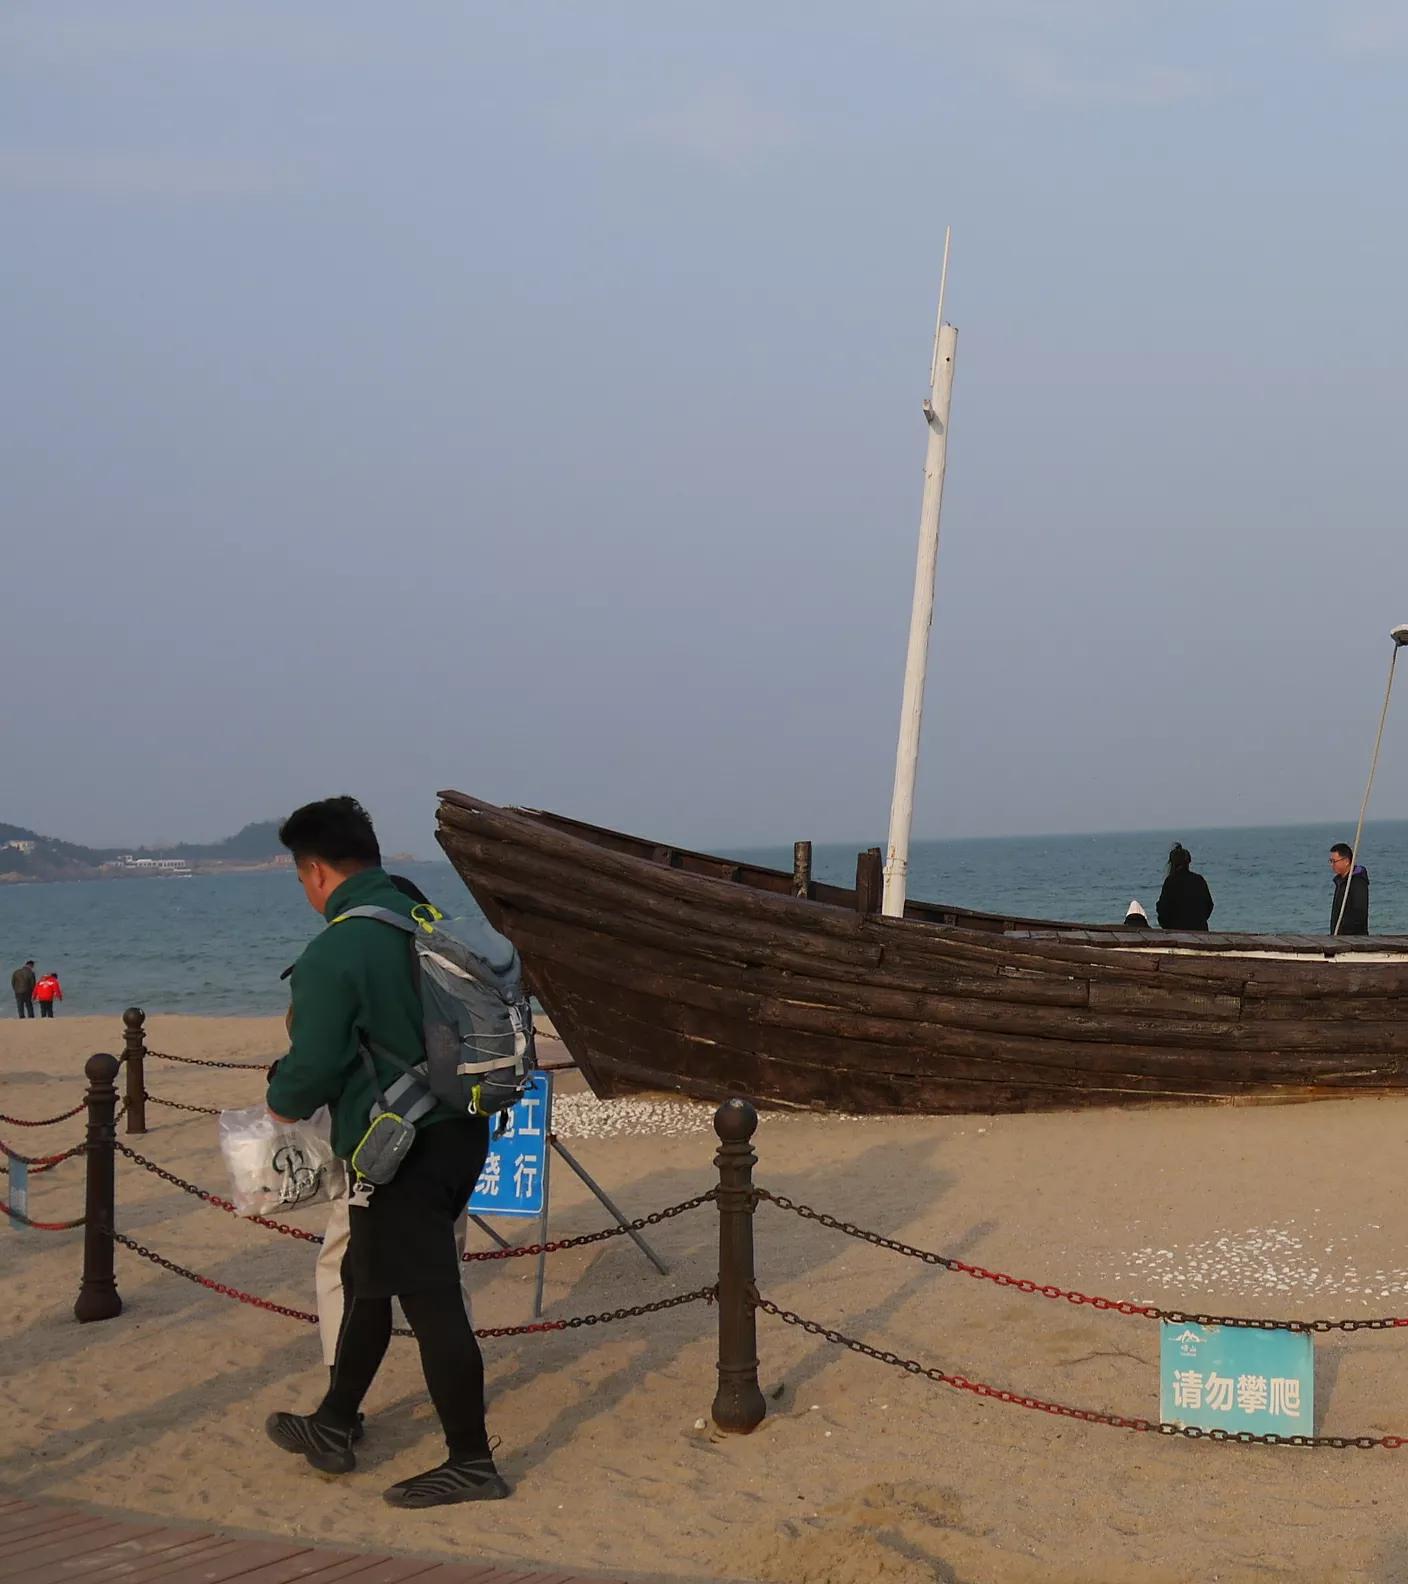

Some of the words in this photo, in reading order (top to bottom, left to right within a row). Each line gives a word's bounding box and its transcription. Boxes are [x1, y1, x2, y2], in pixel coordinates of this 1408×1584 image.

[475, 1152, 537, 1199] 绕行
[1172, 1369, 1301, 1417] 请勿攀爬
